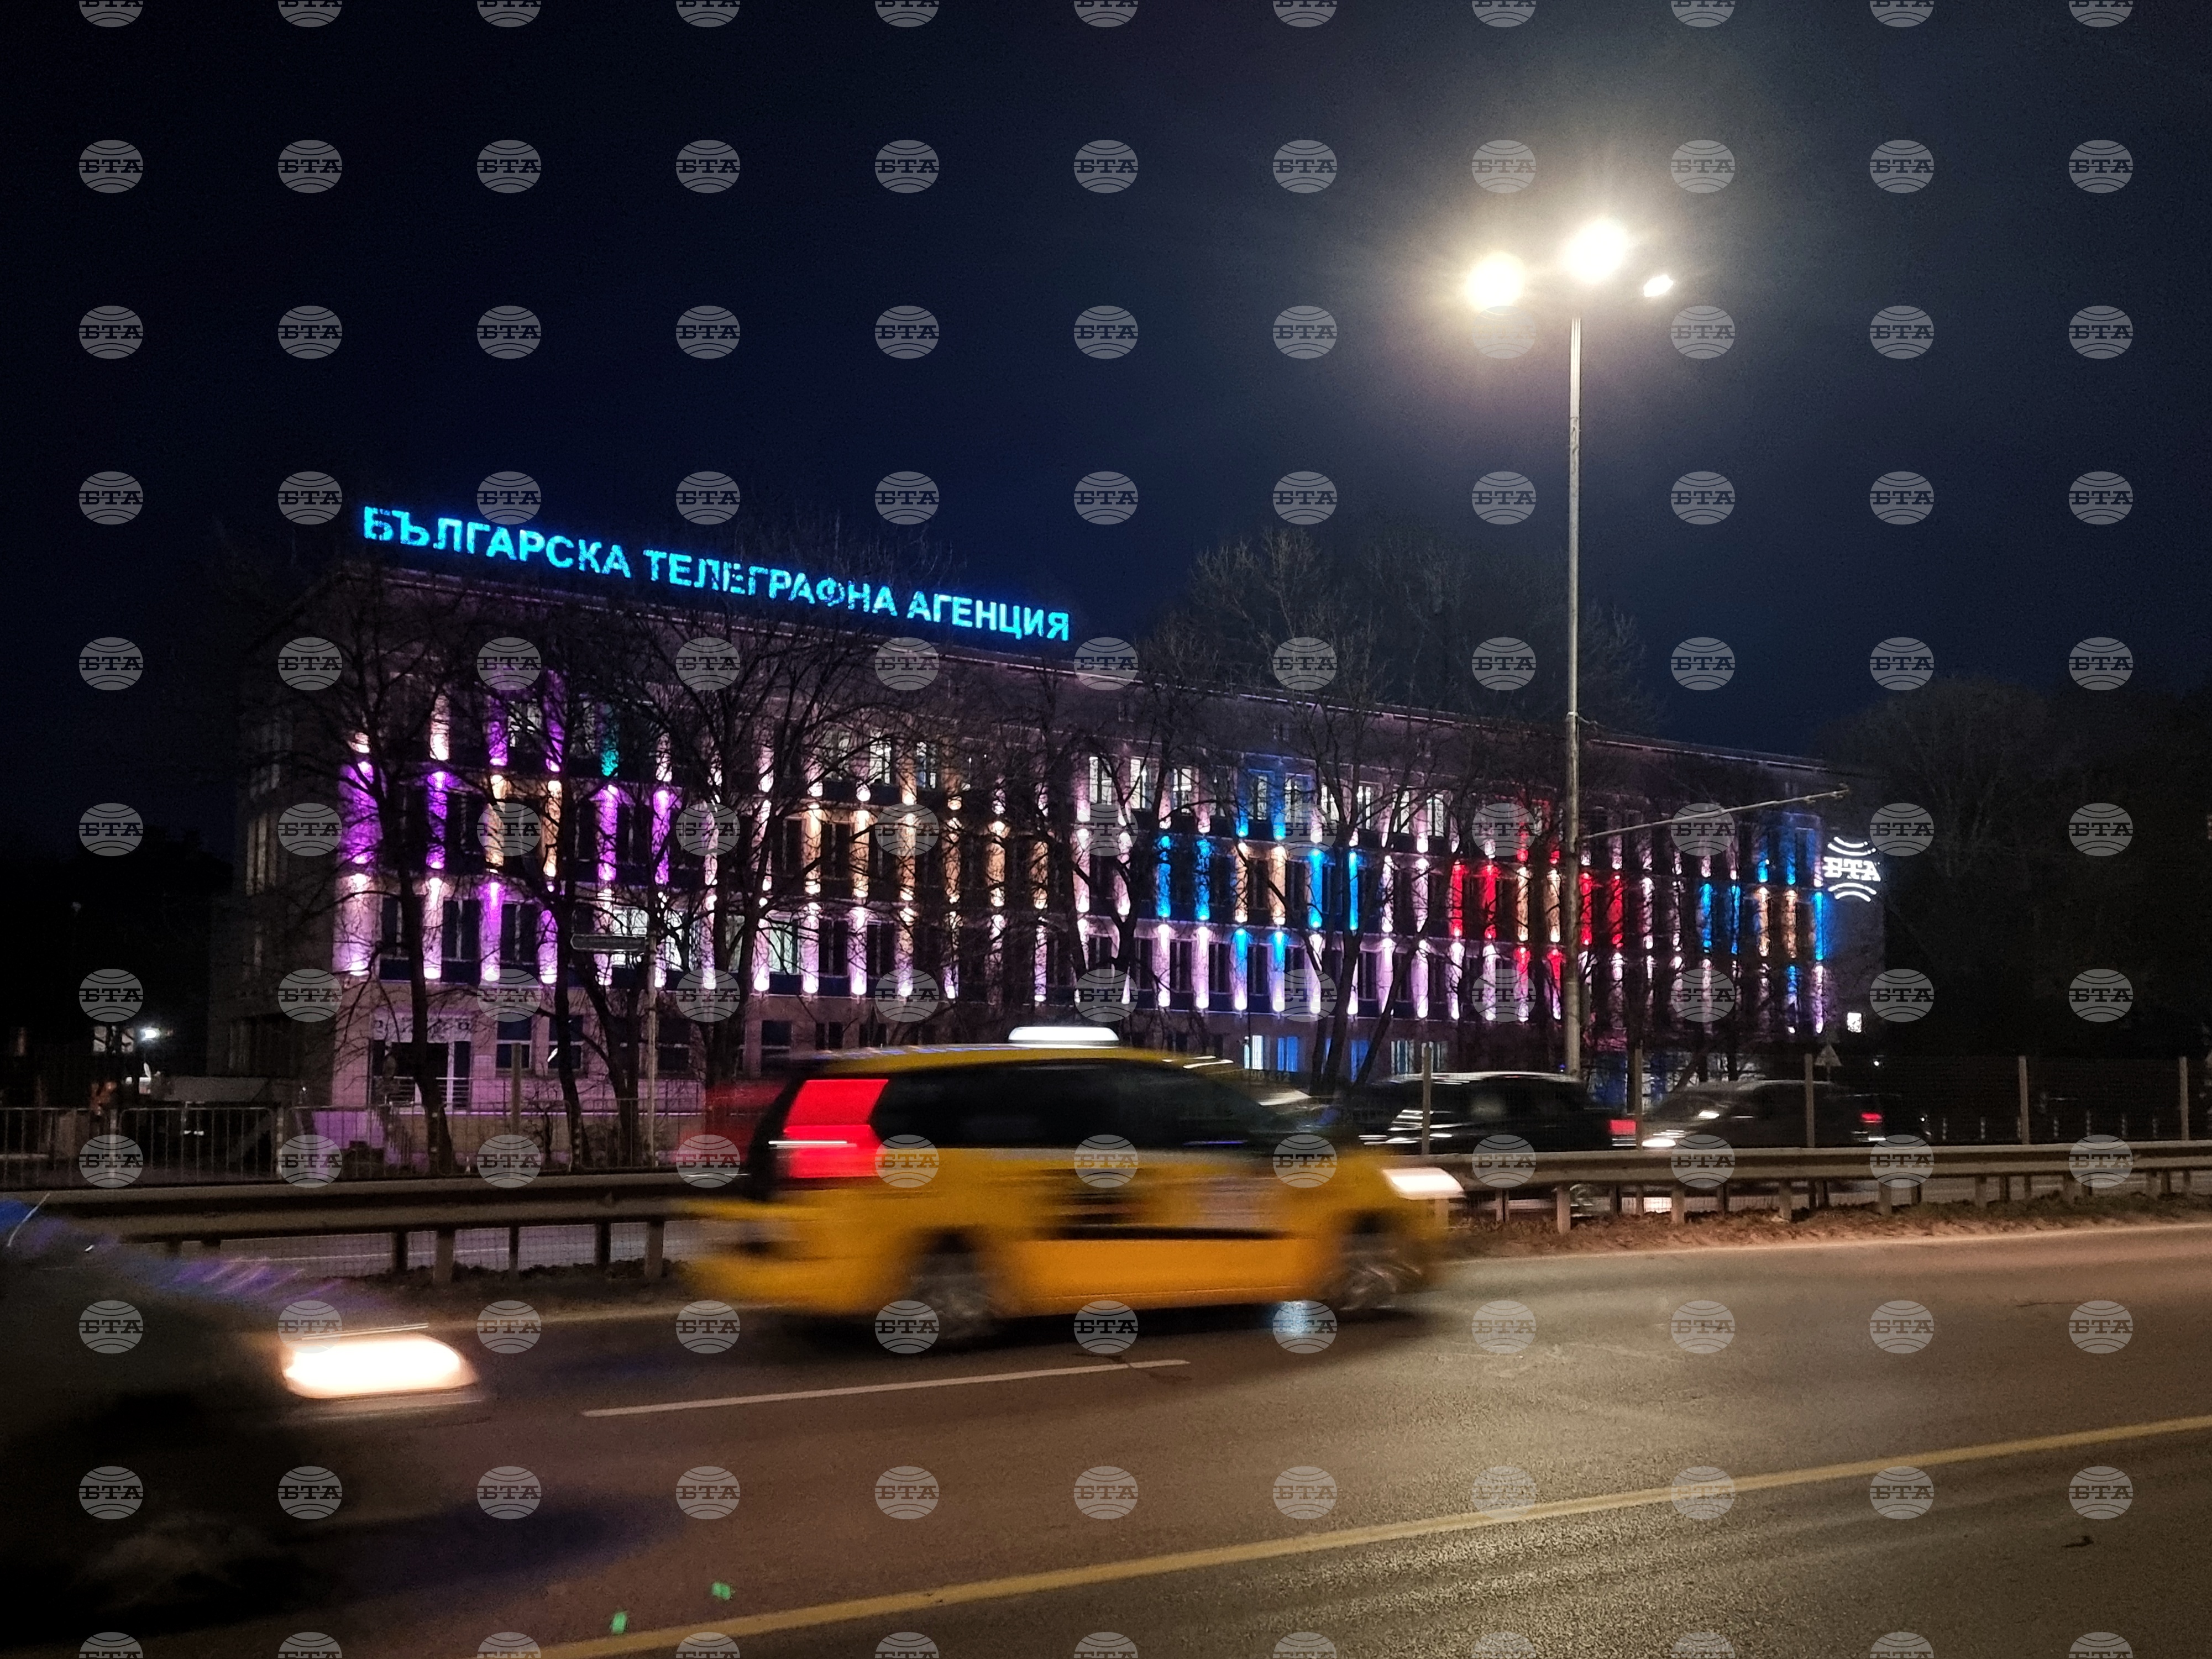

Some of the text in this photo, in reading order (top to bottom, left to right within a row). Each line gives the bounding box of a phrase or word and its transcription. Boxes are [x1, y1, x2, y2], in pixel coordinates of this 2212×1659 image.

[364, 506, 1069, 641] БЪЛГАРСКА ТЕЛЕГРАФНА АГЕНЦИЯ
